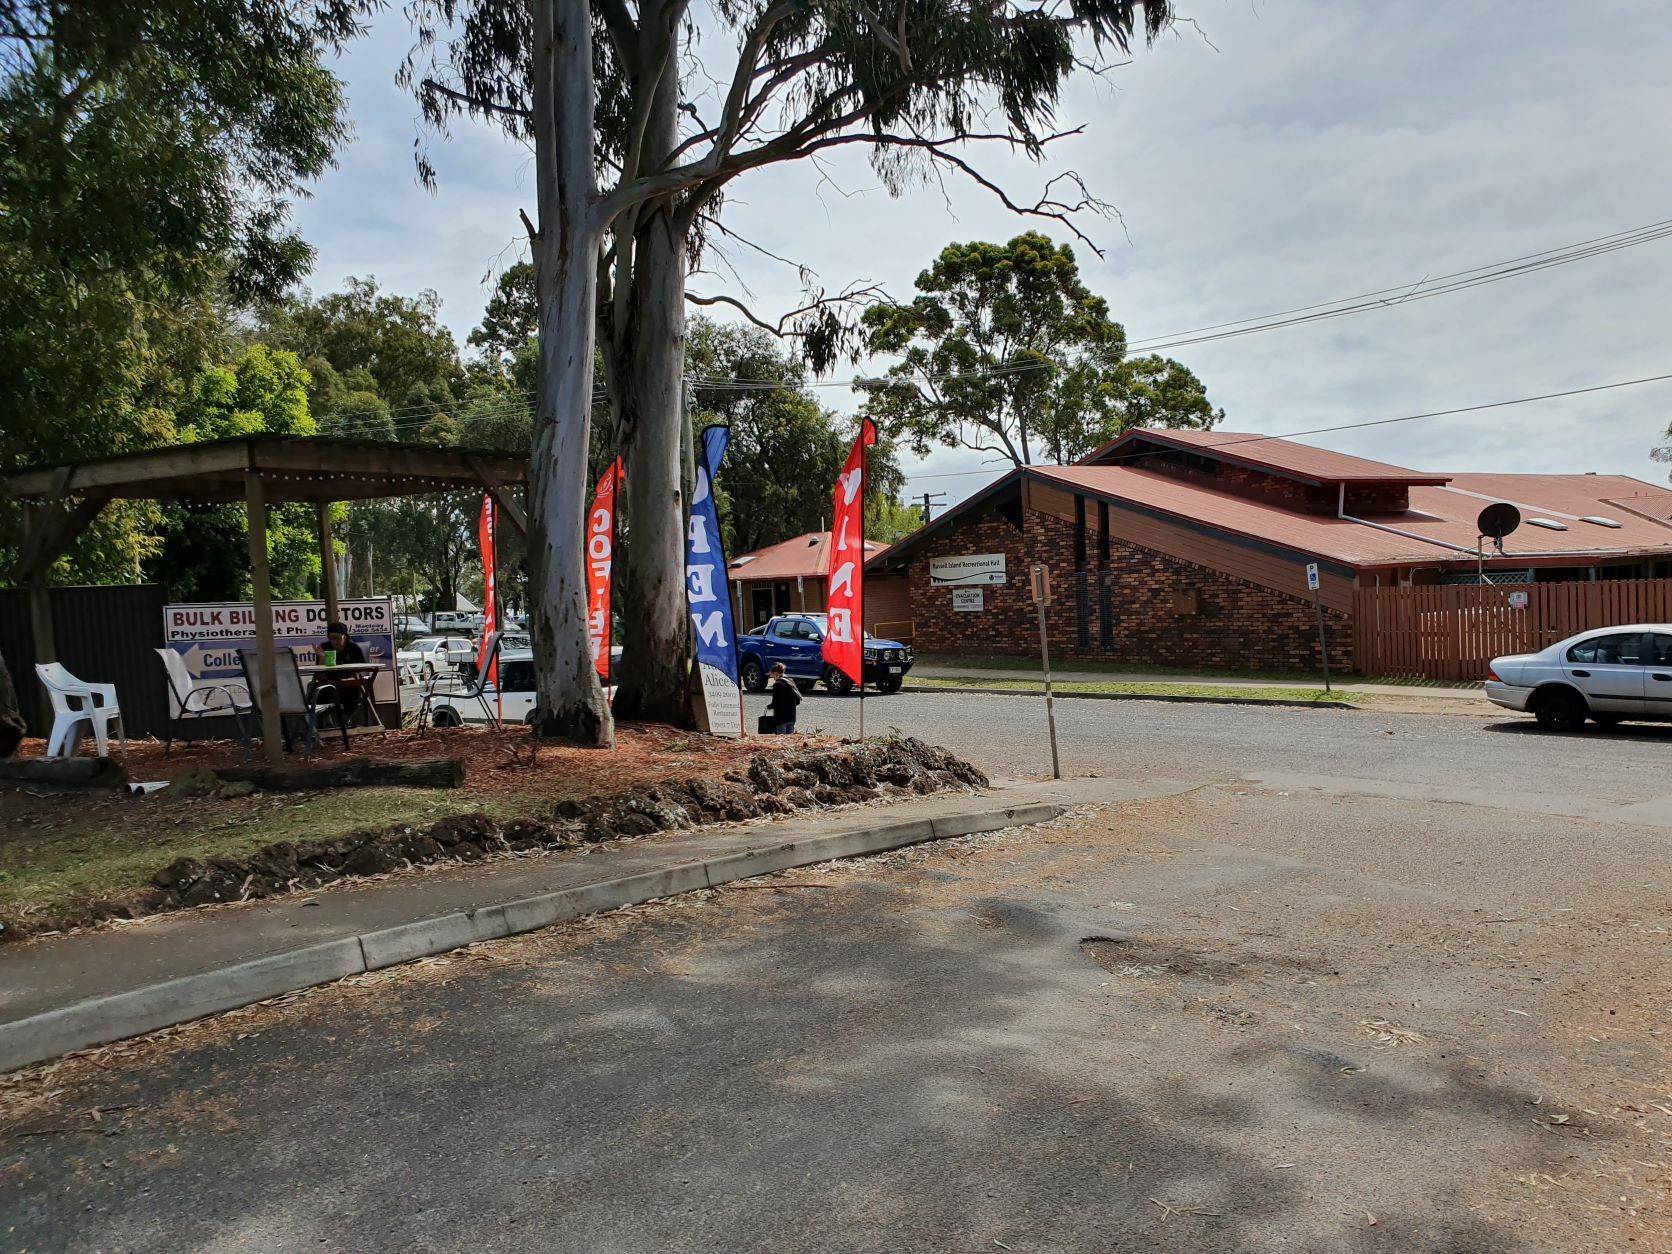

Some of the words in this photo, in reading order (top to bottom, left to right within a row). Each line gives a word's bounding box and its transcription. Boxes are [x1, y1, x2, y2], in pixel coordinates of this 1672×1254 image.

[963, 560, 989, 568] Recreational
[172, 611, 223, 627] BULK
[229, 608, 300, 625] BILNG
[306, 606, 385, 622] DOTORS
[171, 627, 281, 640] Physiotherast
[286, 626, 307, 634] Ph:
[705, 673, 736, 687] Alices
